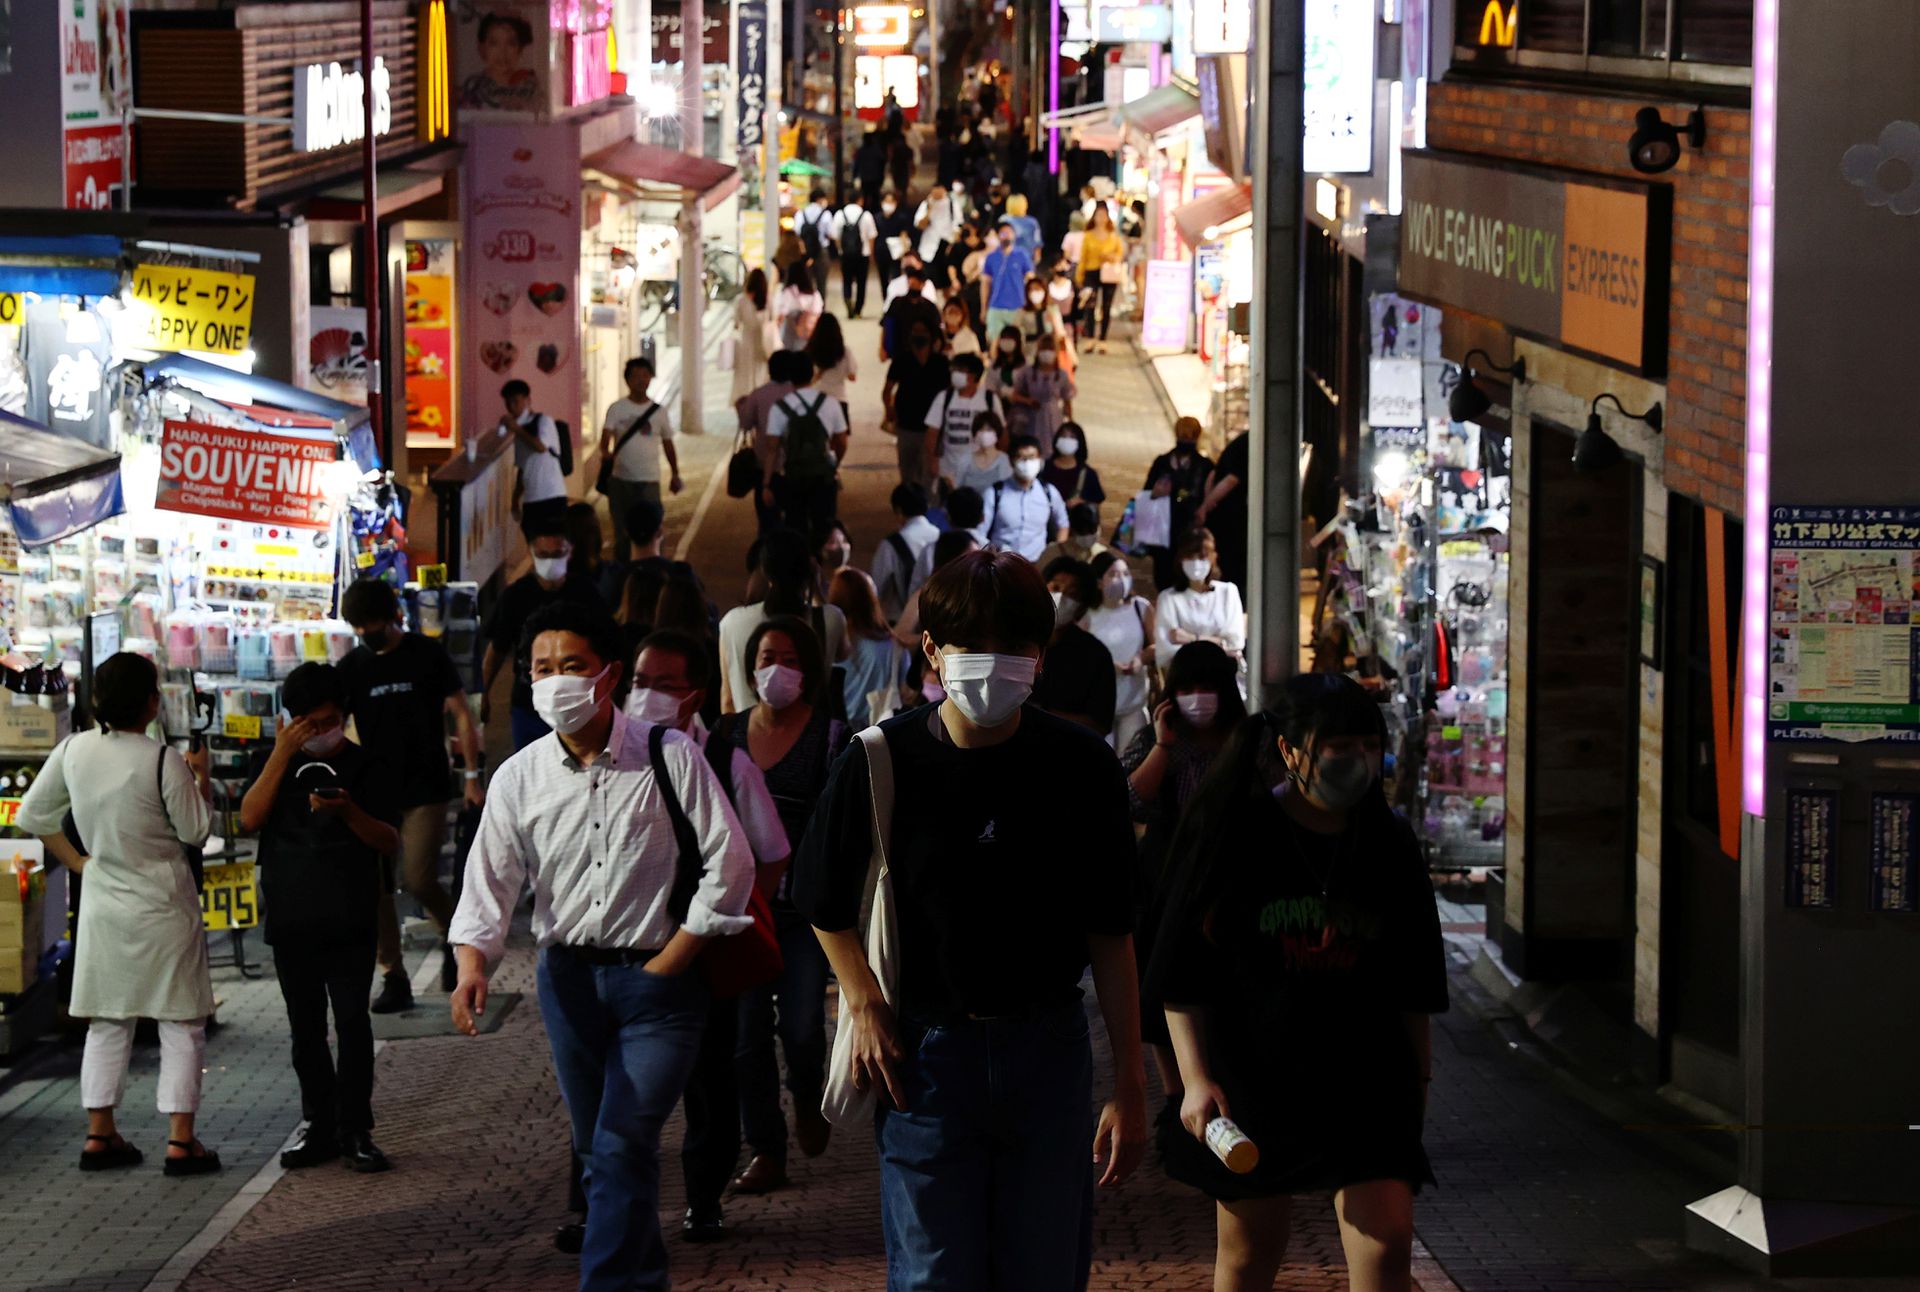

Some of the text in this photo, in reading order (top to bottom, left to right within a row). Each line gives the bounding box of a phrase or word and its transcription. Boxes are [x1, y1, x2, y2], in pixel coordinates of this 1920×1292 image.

[1407, 202, 1641, 309] WOLFGANG PUCK EXPRESS
[136, 277, 249, 313] ハッピーワン
[204, 321, 246, 350] ONE
[170, 427, 248, 450] HARAJUKU
[251, 439, 301, 458] HAPPY
[180, 491, 244, 512] Chopsticks
[1830, 540, 1868, 549] STREET
